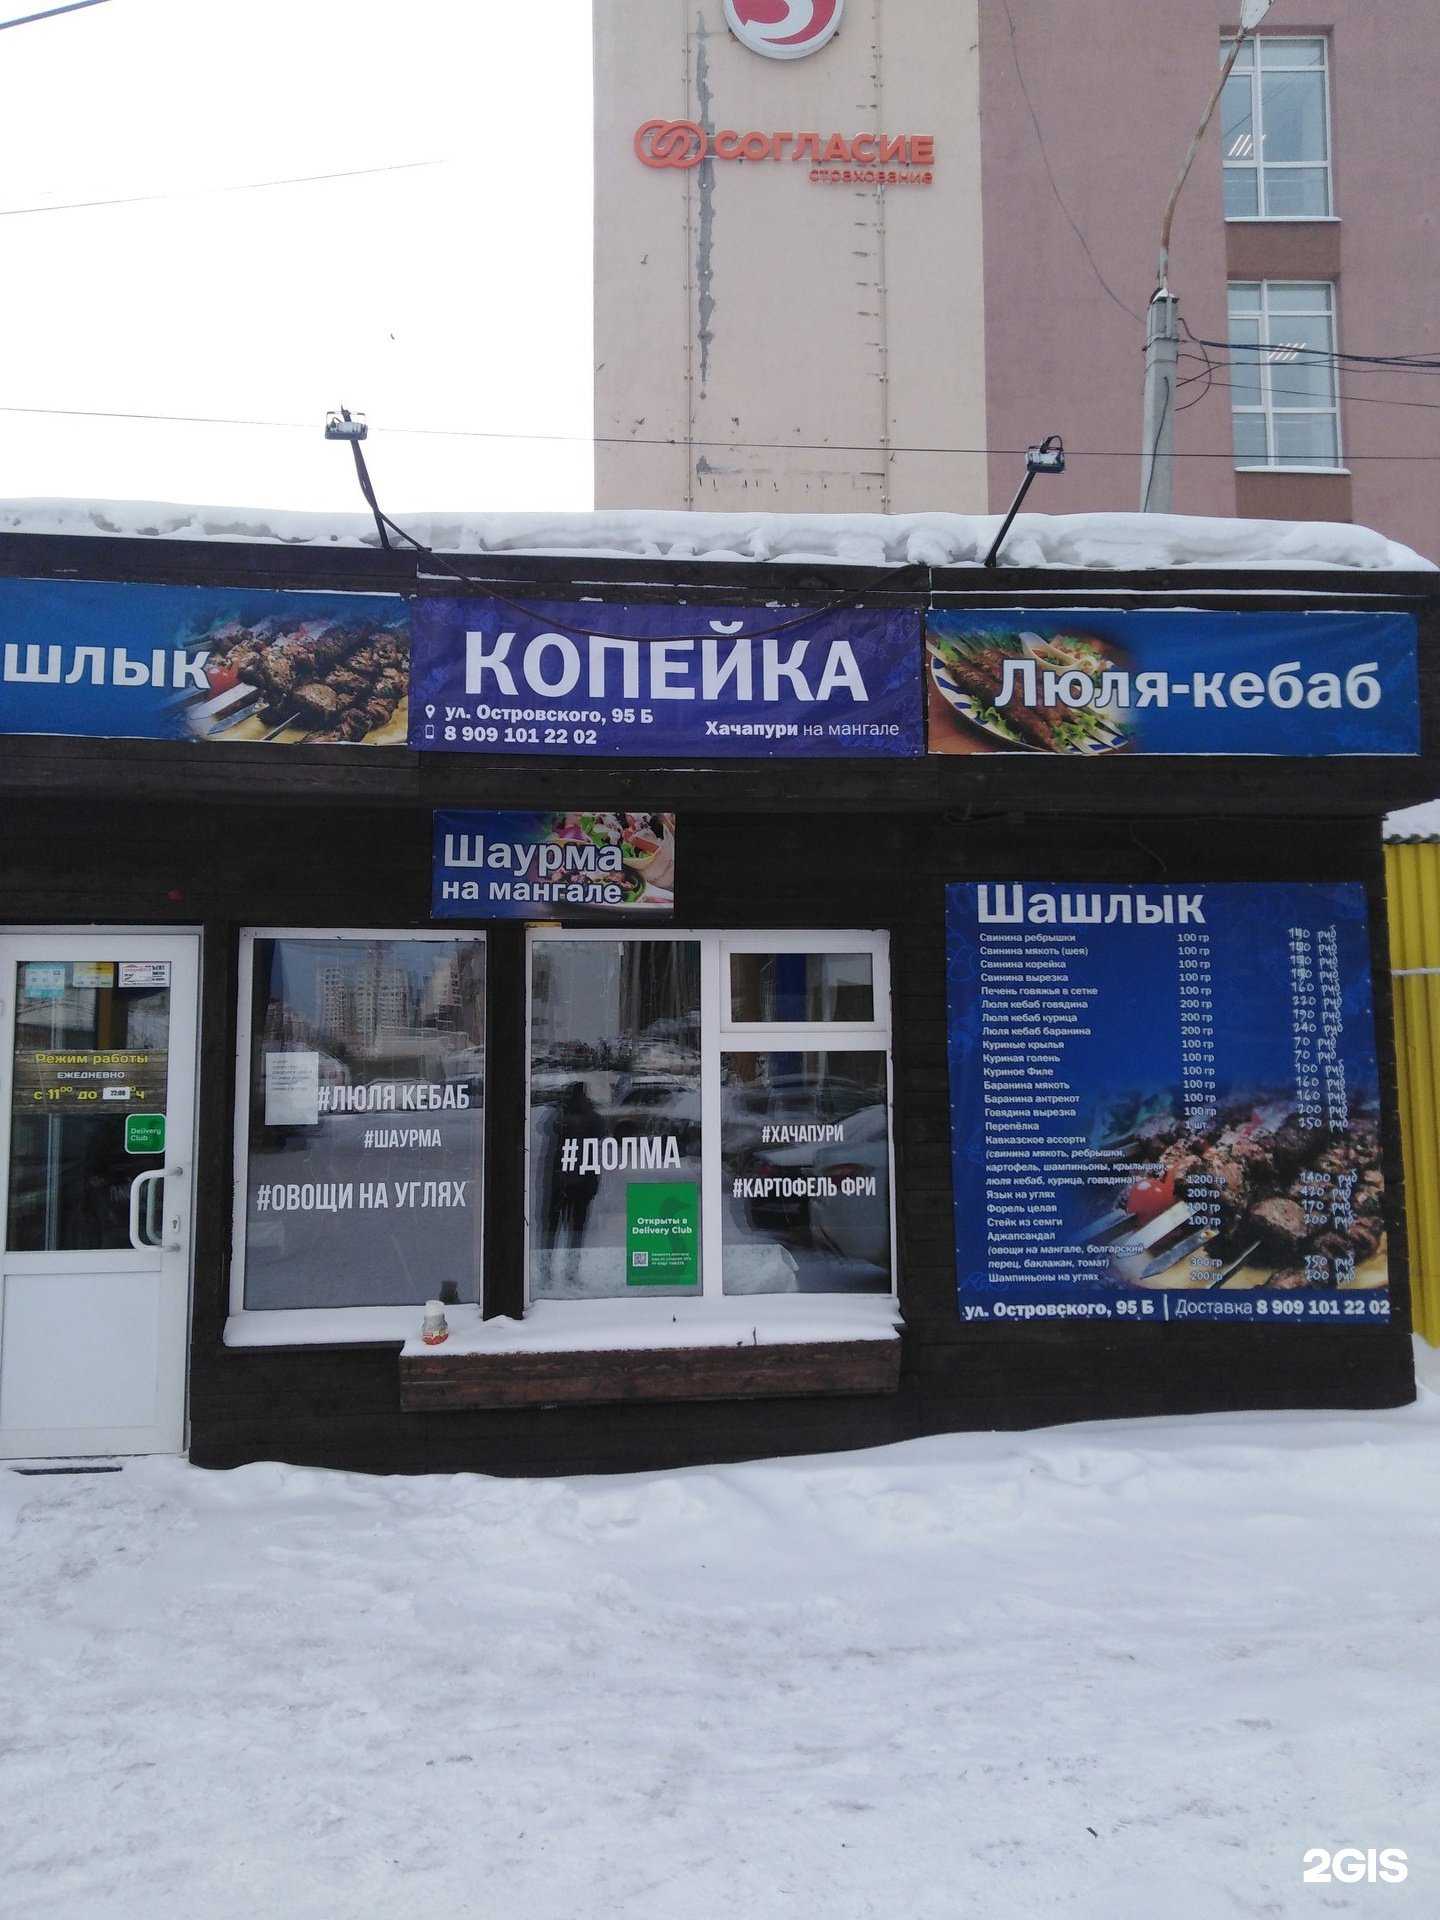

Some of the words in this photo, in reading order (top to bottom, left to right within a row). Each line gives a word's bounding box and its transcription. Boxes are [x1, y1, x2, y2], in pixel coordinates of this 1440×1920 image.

[714, 130, 935, 164] СОГЛАСИЕ
[809, 168, 933, 186] страхование
[3, 643, 211, 689] шлык
[464, 620, 869, 702] КОПЕЙКА
[994, 659, 1382, 709] Люля-кебаб
[445, 706, 470, 722] ул.
[477, 706, 606, 725] Островского,
[612, 707, 635, 724] 95
[641, 708, 653, 724] Б
[445, 726, 455, 741] 8
[462, 726, 499, 742] 909
[504, 728, 539, 743] 101
[544, 728, 569, 744] 22
[573, 729, 597, 744] 02
[705, 720, 798, 739] Хачапури
[803, 723, 824, 736] на
[829, 722, 899, 738] мангале
[444, 835, 623, 876] Шаурма
[442, 881, 479, 900] на
[490, 882, 622, 903] мангале
[978, 884, 1207, 924] Шашлык
[980, 933, 1022, 941] Свинина
[1024, 933, 1076, 945] ребрышки
[1178, 934, 1196, 942] 100
[1198, 935, 1209, 945] гр
[980, 947, 1022, 955] Свинина
[1061, 947, 1088, 956] (шея)
[1179, 947, 1196, 955] 100
[1199, 948, 1210, 958] гр
[980, 960, 1023, 968] Свинина
[1025, 960, 1066, 971] корейка
[1179, 960, 1197, 968] 100
[1200, 962, 1210, 971] гр
[981, 974, 1023, 982] Свинина
[1026, 974, 1068, 984] вырезка
[1179, 974, 1198, 982] 100
[1200, 975, 1211, 985] гр
[981, 987, 1017, 995] Печень
[1180, 987, 1198, 995] 100
[1201, 988, 1211, 998] гр
[981, 1000, 1007, 1009] Люля
[1011, 1000, 1040, 1009] кебаб
[1043, 1001, 1088, 1010] говядина
[1180, 1000, 1199, 1008] 200
[1201, 1002, 1212, 1011] гр
[982, 1014, 1008, 1022] Люля
[1011, 1013, 1040, 1022] кебаб
[1043, 1015, 1077, 1025] курица
[1181, 1014, 1199, 1022] 200
[1202, 1015, 1212, 1024] гр
[982, 1027, 1009, 1036] Люля
[1012, 1026, 1041, 1036] кебаб
[1043, 1026, 1091, 1036] баранина
[1181, 1027, 1200, 1035] 200
[1202, 1028, 1213, 1038] гр
[983, 1041, 1025, 1050] Куриные
[1028, 1042, 1064, 1050] крылья
[36, 1054, 87, 1064] Режим
[93, 1054, 148, 1065] работы
[983, 1054, 1024, 1064] Куриная
[1027, 1055, 1060, 1063] голень
[983, 1068, 1025, 1077] Куриное
[1028, 1067, 1053, 1076] Филе
[984, 1081, 1032, 1091] Баранина
[1035, 1082, 1070, 1090] мякоть
[77, 1091, 97, 1100] до
[318, 1085, 397, 1111] #ЛЮЛЯ
[402, 1084, 469, 1109] КЕБАБ
[985, 1095, 1033, 1104] Баранина
[1035, 1095, 1079, 1104] антрекот
[985, 1109, 1031, 1118] Говядина
[1033, 1109, 1076, 1119] вырезка
[365, 1130, 442, 1148] #ШАУРМА
[762, 1124, 844, 1143] #ХАЧАПУРИ
[985, 1136, 1044, 1144] Кавказское
[1046, 1136, 1086, 1147] ассорти
[561, 1136, 681, 1175] #ДОЛМА
[986, 1149, 1030, 1159] (свинина
[733, 1178, 837, 1199] #КАРТОФЕЛЬ
[842, 1177, 876, 1197] ФРИ
[257, 1183, 353, 1212] #ОВОЩИ
[360, 1183, 388, 1209] НА
[395, 1182, 466, 1208] УГЛЯХ
[986, 1191, 1013, 1199] Язык
[1029, 1191, 1055, 1202] углях
[987, 1204, 1025, 1215] Форель
[1027, 1205, 1057, 1214] целая
[637, 1218, 680, 1226] Открыты
[987, 1218, 1016, 1226] Стейк
[632, 1227, 669, 1235] Delivery
[672, 1226, 692, 1234] Club
[988, 1232, 1055, 1242] Аджапсандал
[988, 1245, 1023, 1256] (овощи
[989, 1274, 1056, 1282] Шампиньоны
[1073, 1274, 1099, 1285] углях
[965, 1304, 988, 1320] ул.
[994, 1302, 1112, 1318] Островского,
[1116, 1301, 1137, 1314] 95
[1142, 1301, 1154, 1314] Б
[1176, 1300, 1252, 1315] Доставка
[1257, 1300, 1268, 1314] 8
[1272, 1300, 1304, 1314] 909
[1309, 1300, 1340, 1314] 101
[1345, 1300, 1365, 1314] 22
[1369, 1300, 1390, 1314] 02
